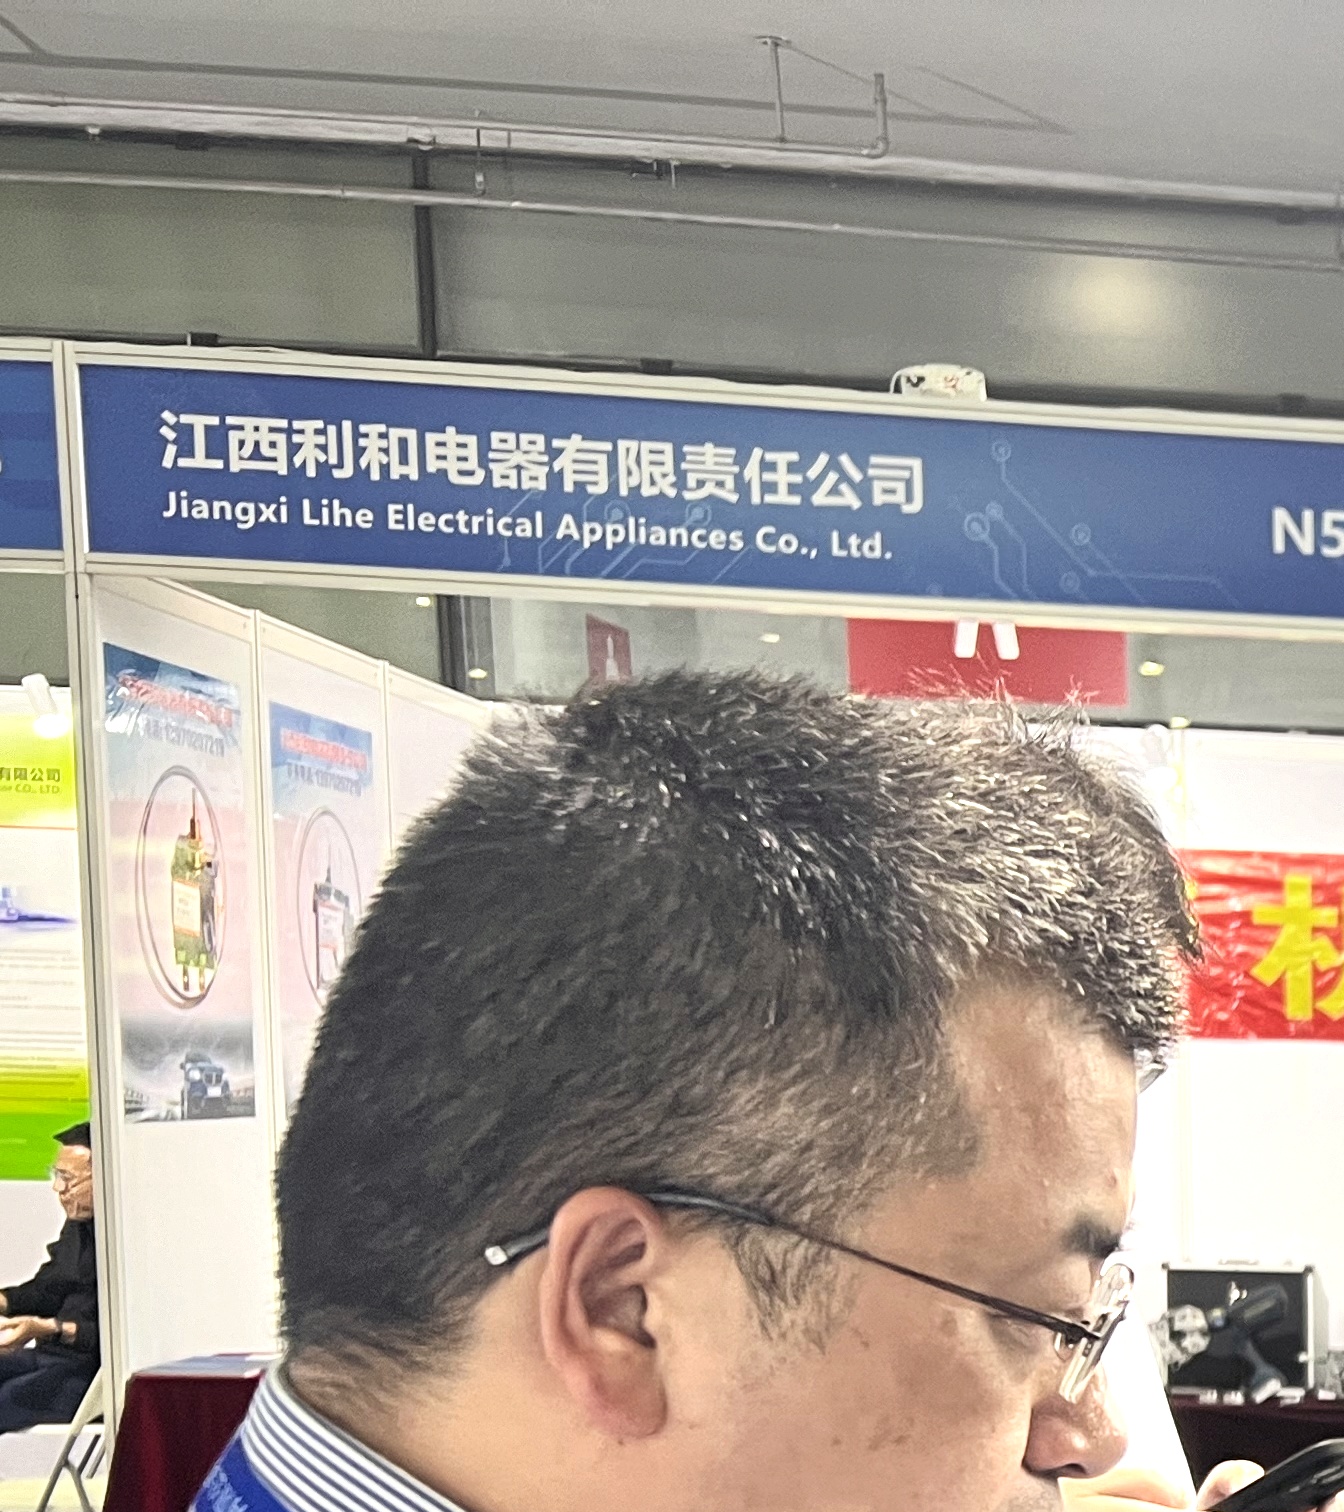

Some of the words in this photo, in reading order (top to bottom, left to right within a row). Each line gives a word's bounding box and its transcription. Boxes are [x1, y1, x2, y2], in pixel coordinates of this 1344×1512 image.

[160, 408, 925, 517] 江西利和电器有限责任公司
[162, 490, 289, 532] Jiangxi
[301, 496, 375, 530] Lihe
[387, 502, 544, 540] Electrical
[555, 513, 745, 552] Appliances
[755, 525, 819, 559] Co.,
[831, 529, 893, 560] Ltd.
